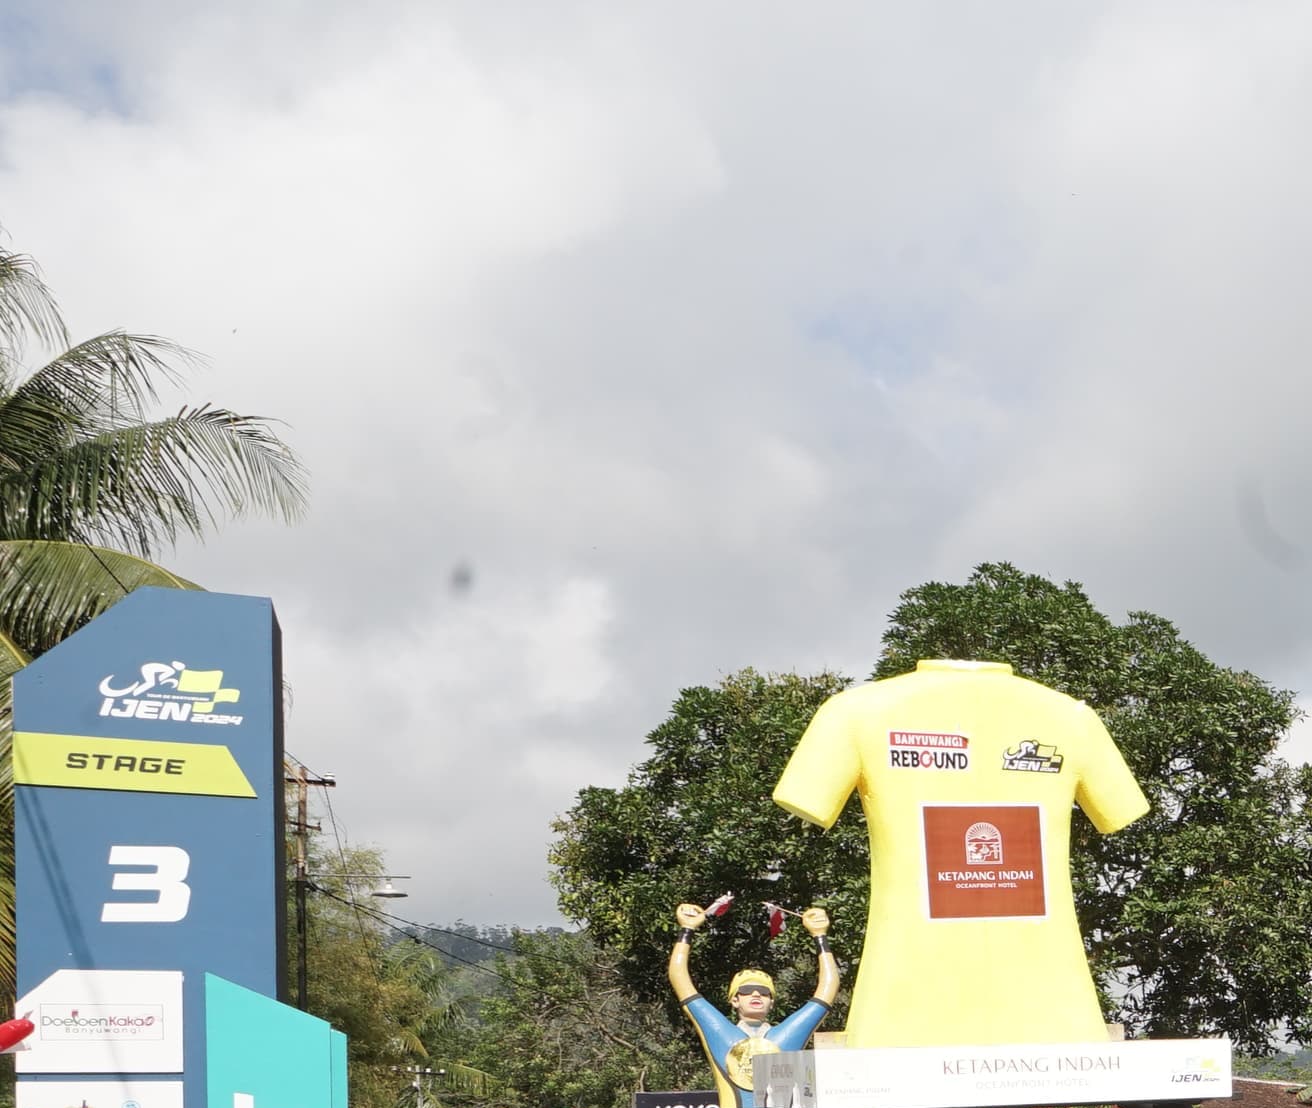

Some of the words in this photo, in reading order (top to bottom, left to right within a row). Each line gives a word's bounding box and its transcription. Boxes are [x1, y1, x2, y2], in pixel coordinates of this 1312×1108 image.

[99, 698, 192, 721] IJEN
[190, 713, 243, 725] 2024
[895, 734, 963, 747] BANYUWANGI
[65, 752, 186, 775] STAGE
[890, 750, 968, 770] REBOUND
[1003, 759, 1041, 771] IJEN
[101, 846, 191, 922] 3
[938, 871, 996, 881] KETAPANG
[998, 871, 1034, 880] INDAH
[943, 1057, 1049, 1075] KETAPANG
[1057, 1055, 1121, 1071] INDAH
[1171, 1074, 1202, 1083] IJEN
